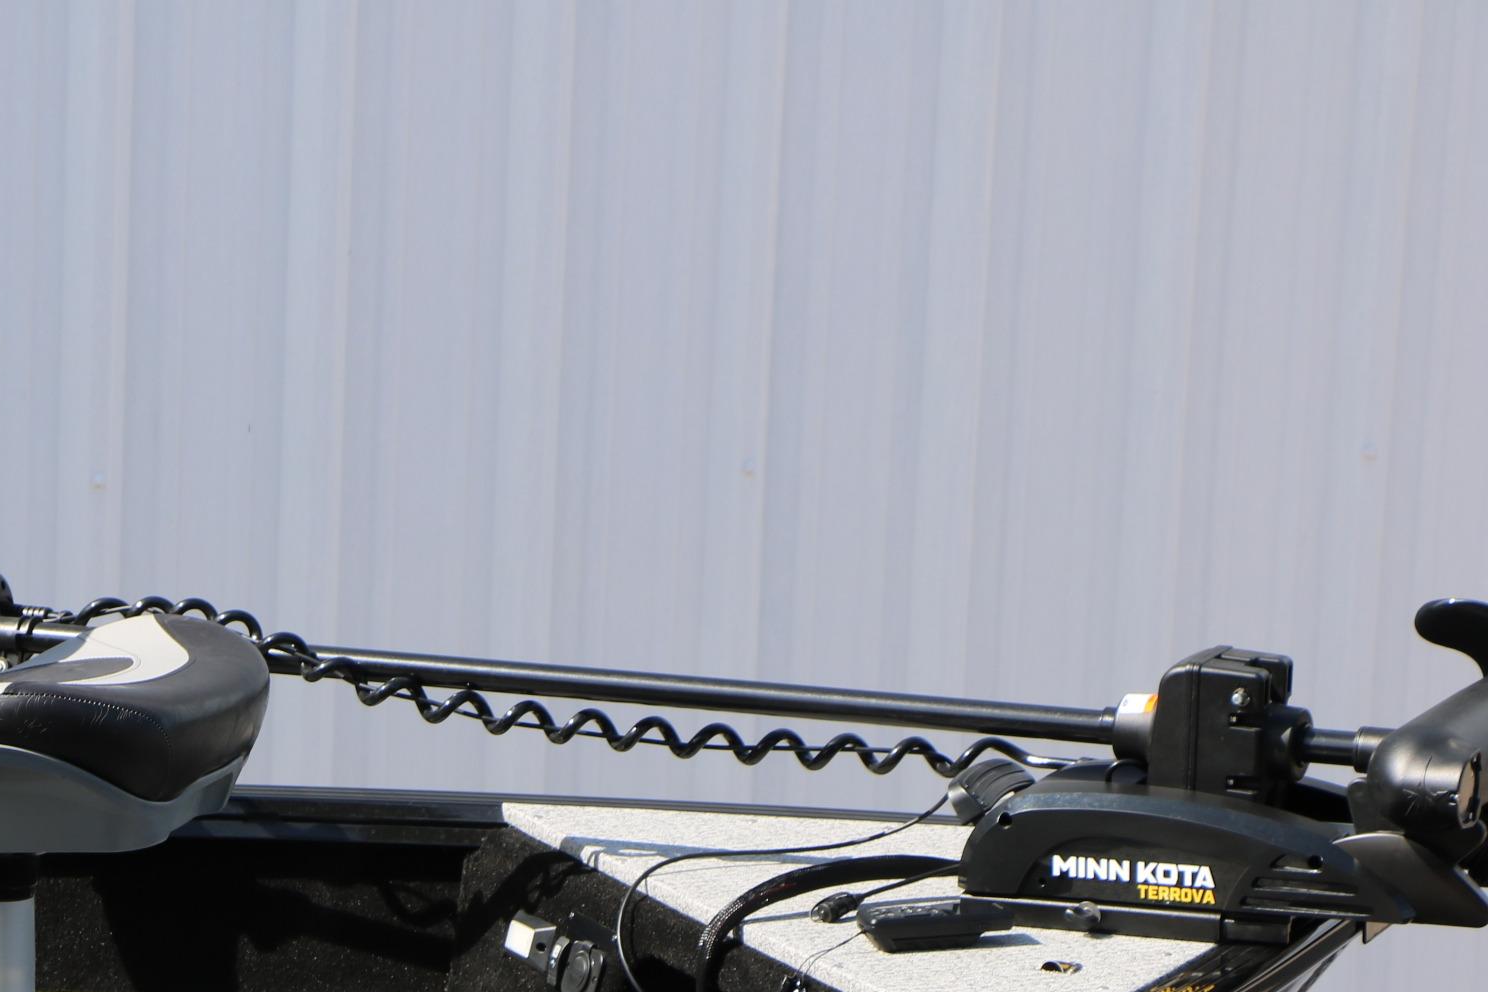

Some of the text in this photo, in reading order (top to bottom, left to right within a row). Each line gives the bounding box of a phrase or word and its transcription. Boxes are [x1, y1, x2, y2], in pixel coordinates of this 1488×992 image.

[1052, 854, 1215, 888] MINN KOTA
[1137, 884, 1215, 904] TERROVA
